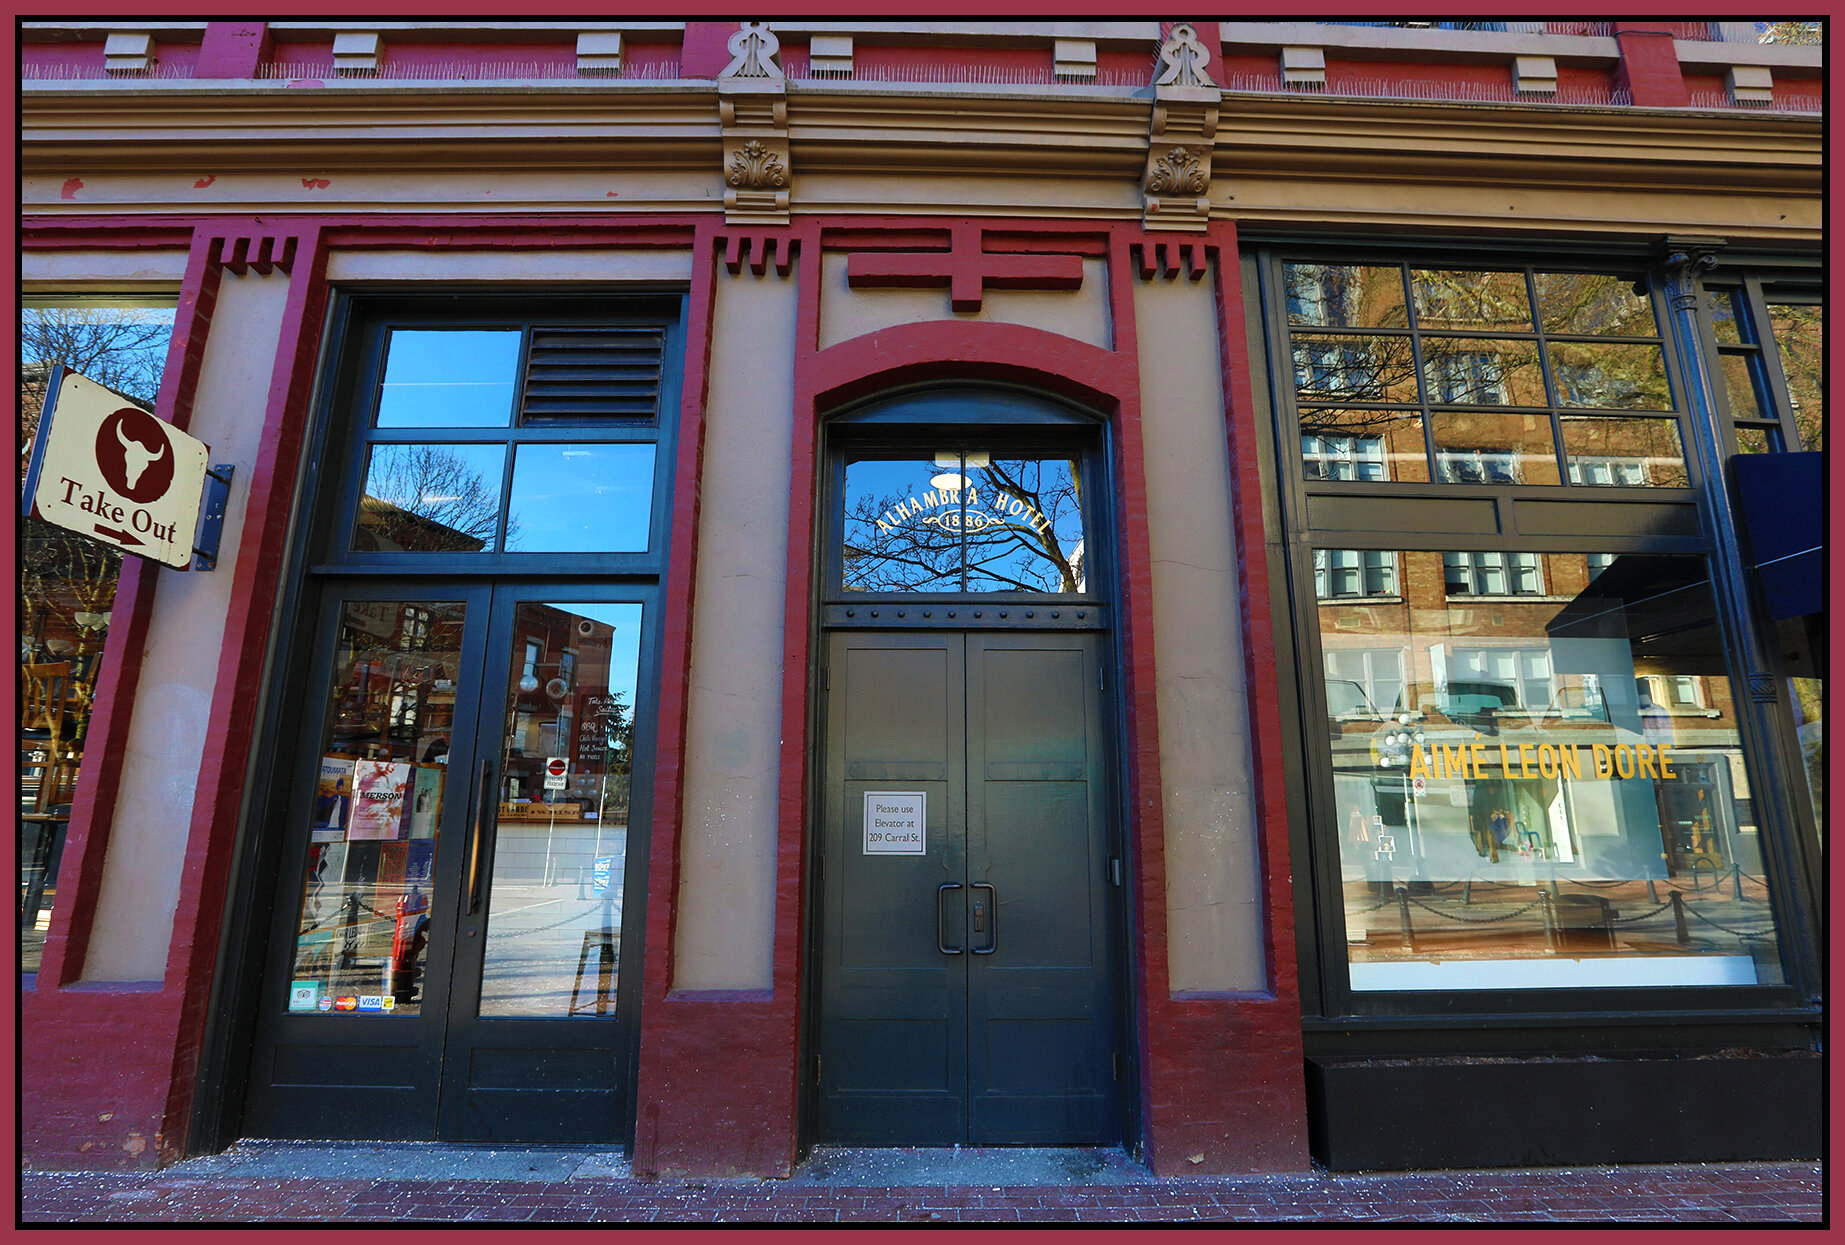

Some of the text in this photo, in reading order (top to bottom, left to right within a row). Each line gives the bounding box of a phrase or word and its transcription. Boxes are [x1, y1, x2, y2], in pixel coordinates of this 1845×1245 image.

[60, 476, 177, 544] Take Out
[876, 487, 1052, 535] ALHAMBRA HOTEL
[944, 515, 984, 527] 1886
[1409, 732, 1677, 779] AIMÉ LEON DORE
[353, 791, 403, 800] MERSON
[876, 804, 899, 813] Please
[875, 818, 915, 828] Elevator at
[869, 832, 921, 842] 209 Carral St.
[361, 998, 380, 1006] VISA
